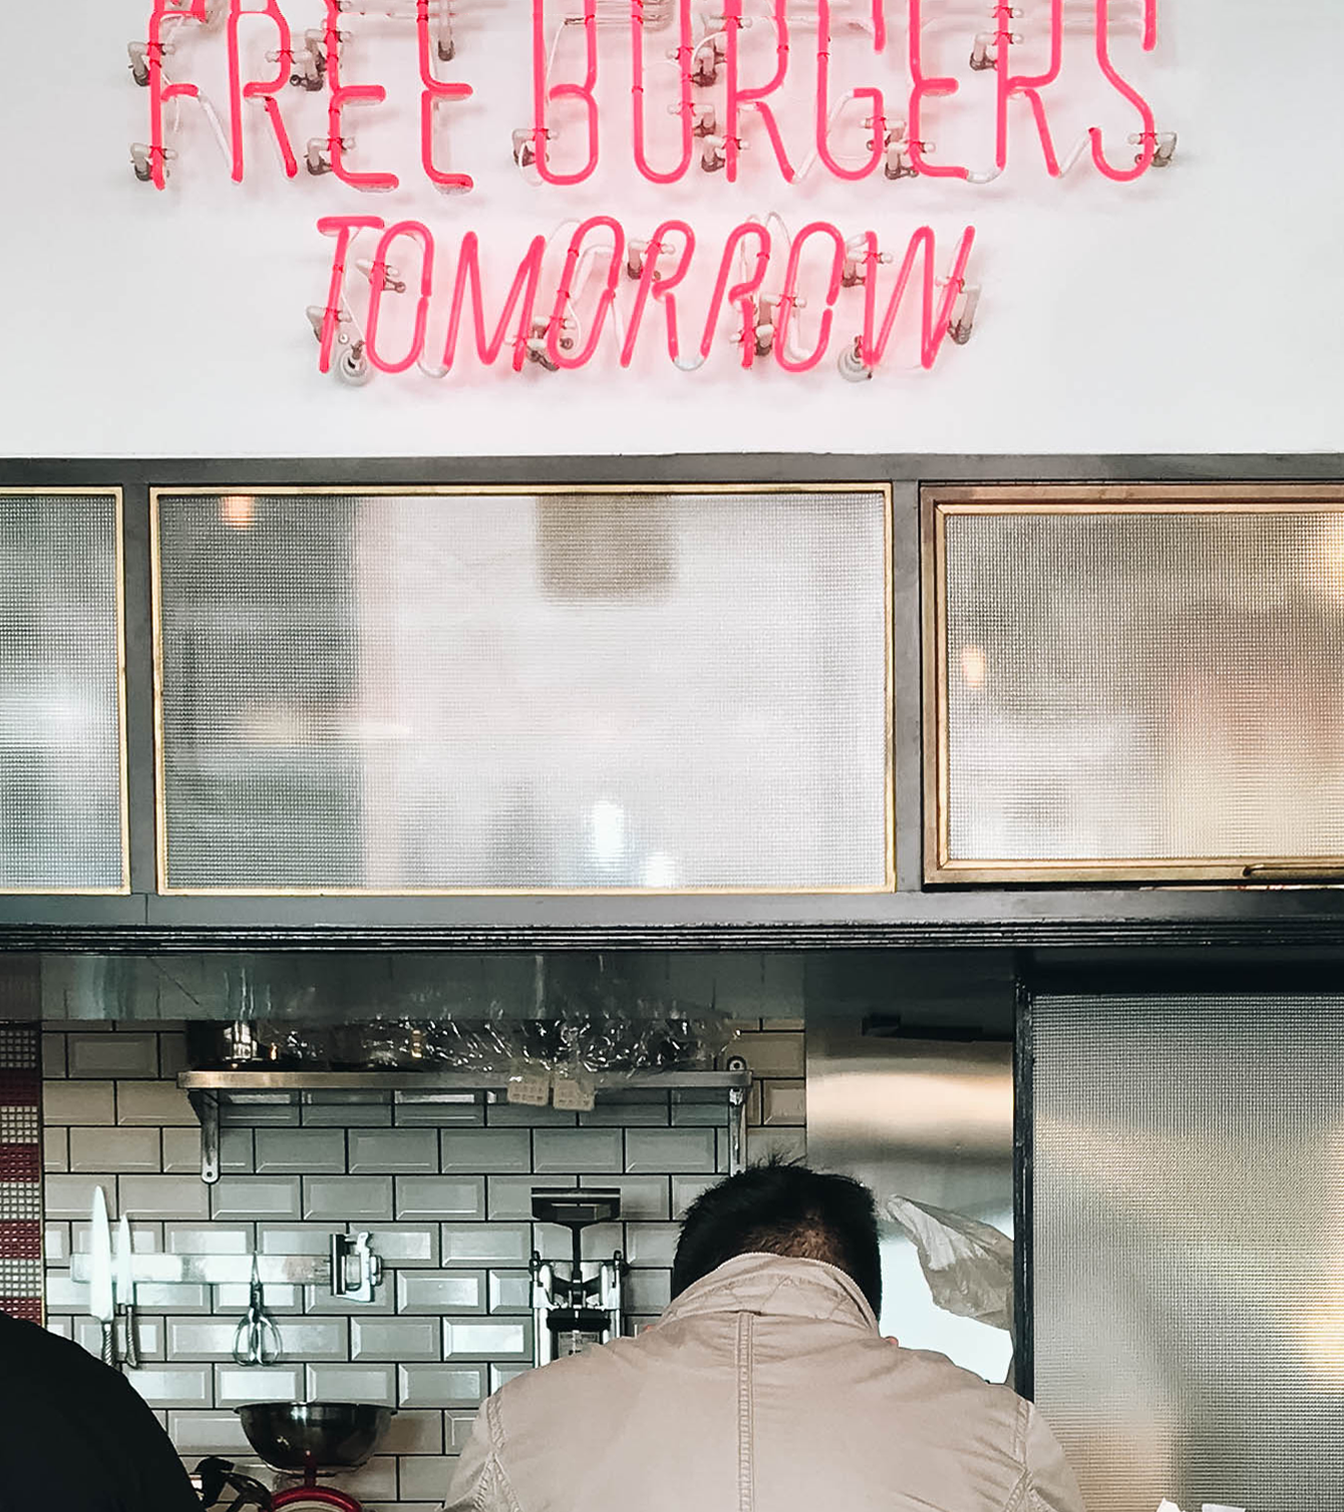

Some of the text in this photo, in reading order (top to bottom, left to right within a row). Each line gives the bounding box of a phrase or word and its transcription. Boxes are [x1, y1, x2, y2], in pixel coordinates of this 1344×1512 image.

[149, 0, 1155, 191] FREE BURGERS
[317, 215, 977, 374] TOMORROW
